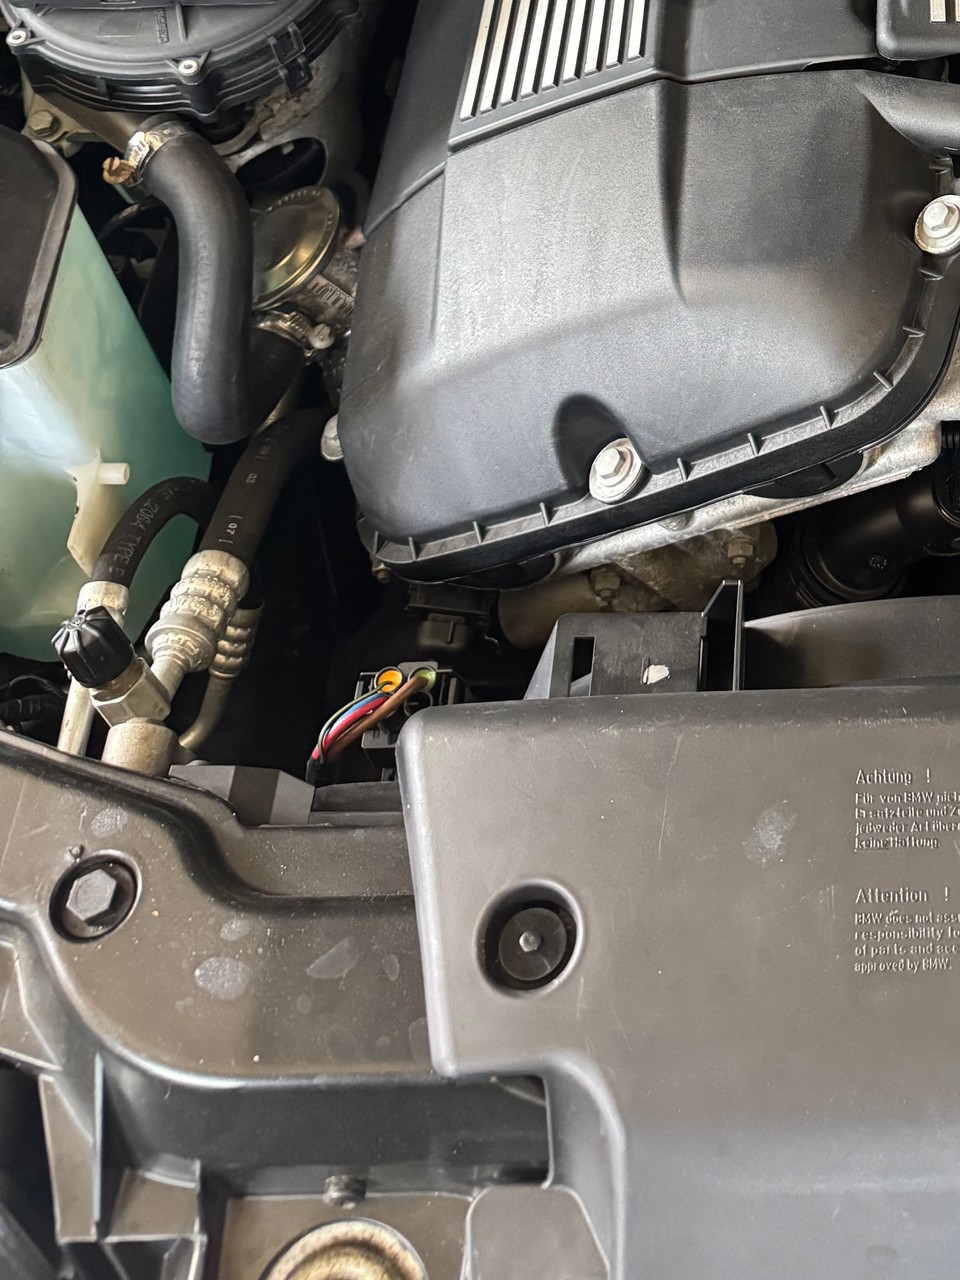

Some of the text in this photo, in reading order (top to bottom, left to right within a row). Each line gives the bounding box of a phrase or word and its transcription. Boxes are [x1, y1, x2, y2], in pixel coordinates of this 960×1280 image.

[855, 768, 912, 786] Achtung
[855, 792, 873, 805] Für
[879, 793, 901, 804] von
[903, 791, 934, 804] BMW
[911, 821, 929, 833] Art
[855, 836, 888, 850] keine
[855, 887, 929, 904] Attention
[854, 912, 883, 925] BMW
[885, 910, 912, 924] does
[915, 911, 933, 923] not
[854, 926, 944, 942] responsibility
[854, 944, 867, 956] of
[870, 943, 907, 959] parts
[910, 942, 933, 954] and
[854, 958, 905, 974] approved
[906, 958, 920, 973] by
